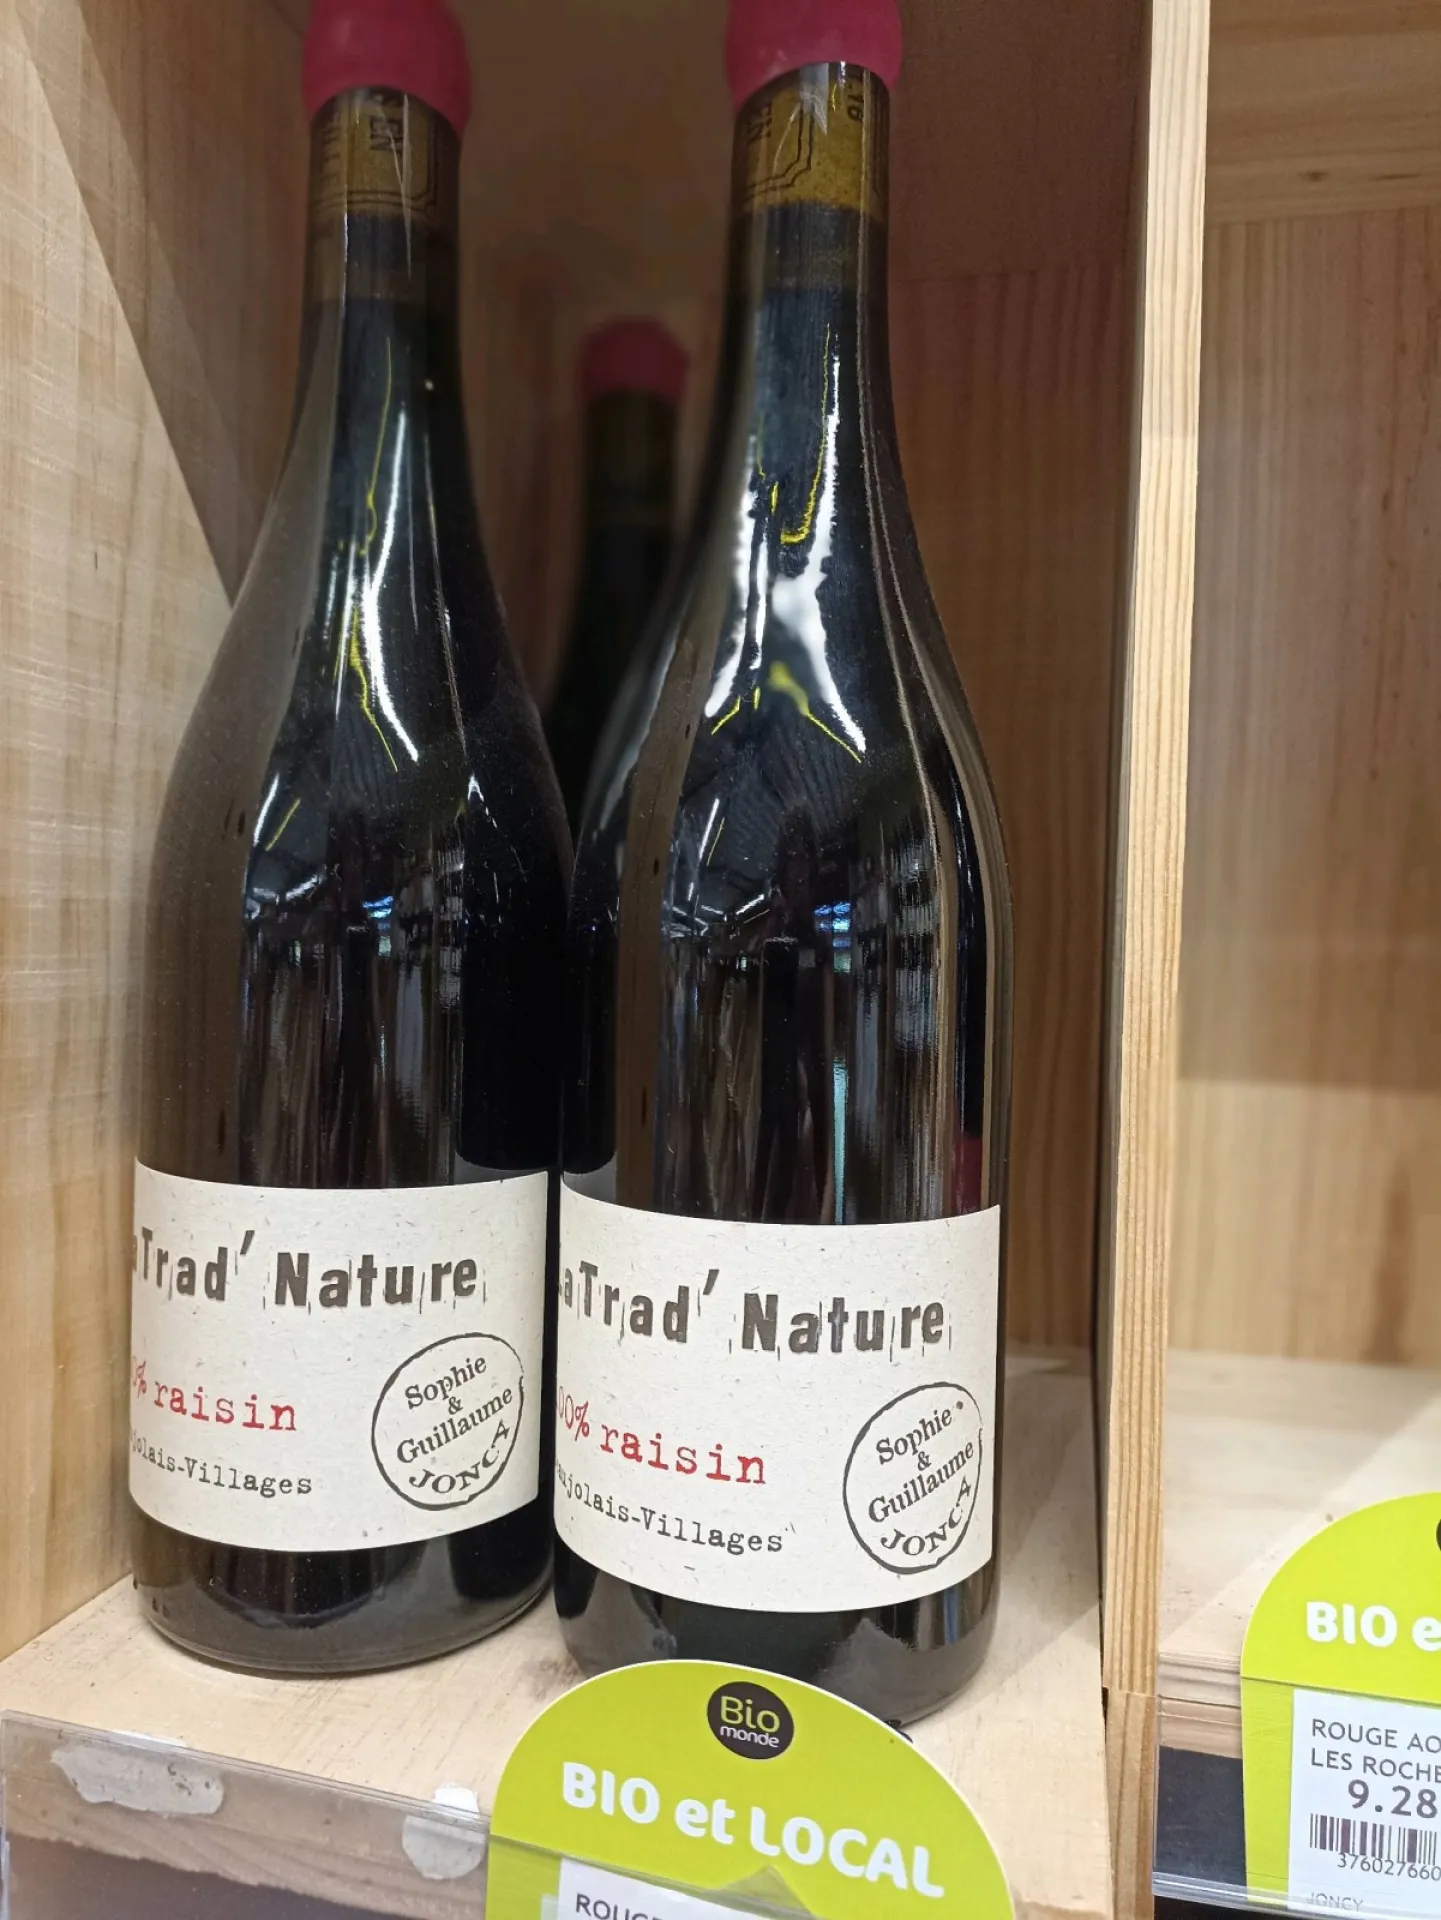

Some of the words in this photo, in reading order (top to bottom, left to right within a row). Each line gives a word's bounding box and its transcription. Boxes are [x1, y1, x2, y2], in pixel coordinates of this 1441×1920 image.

[274, 1252, 478, 1308] Nature
[741, 1292, 944, 1354] Nature
[154, 1380, 297, 1431] raisin
[404, 1356, 487, 1410] Sophie
[447, 1396, 464, 1416] &
[396, 1388, 513, 1464] Guillaume
[876, 1409, 952, 1465] Sophie
[600, 1423, 766, 1485] raisin
[917, 1451, 932, 1472] &
[868, 1442, 974, 1523] Guillaume
[1305, 1601, 1398, 1646] BIO
[719, 1724, 780, 1748] monde
[720, 1696, 780, 1734] Bio
[1311, 1718, 1398, 1749] ROUGE
[1310, 1750, 1353, 1772] LES
[1348, 1778, 1438, 1820] 9.28
[562, 1761, 660, 1824] BIO
[675, 1798, 735, 1845] et
[749, 1805, 945, 1898] LOCAL
[576, 1892, 662, 1920] ROU
